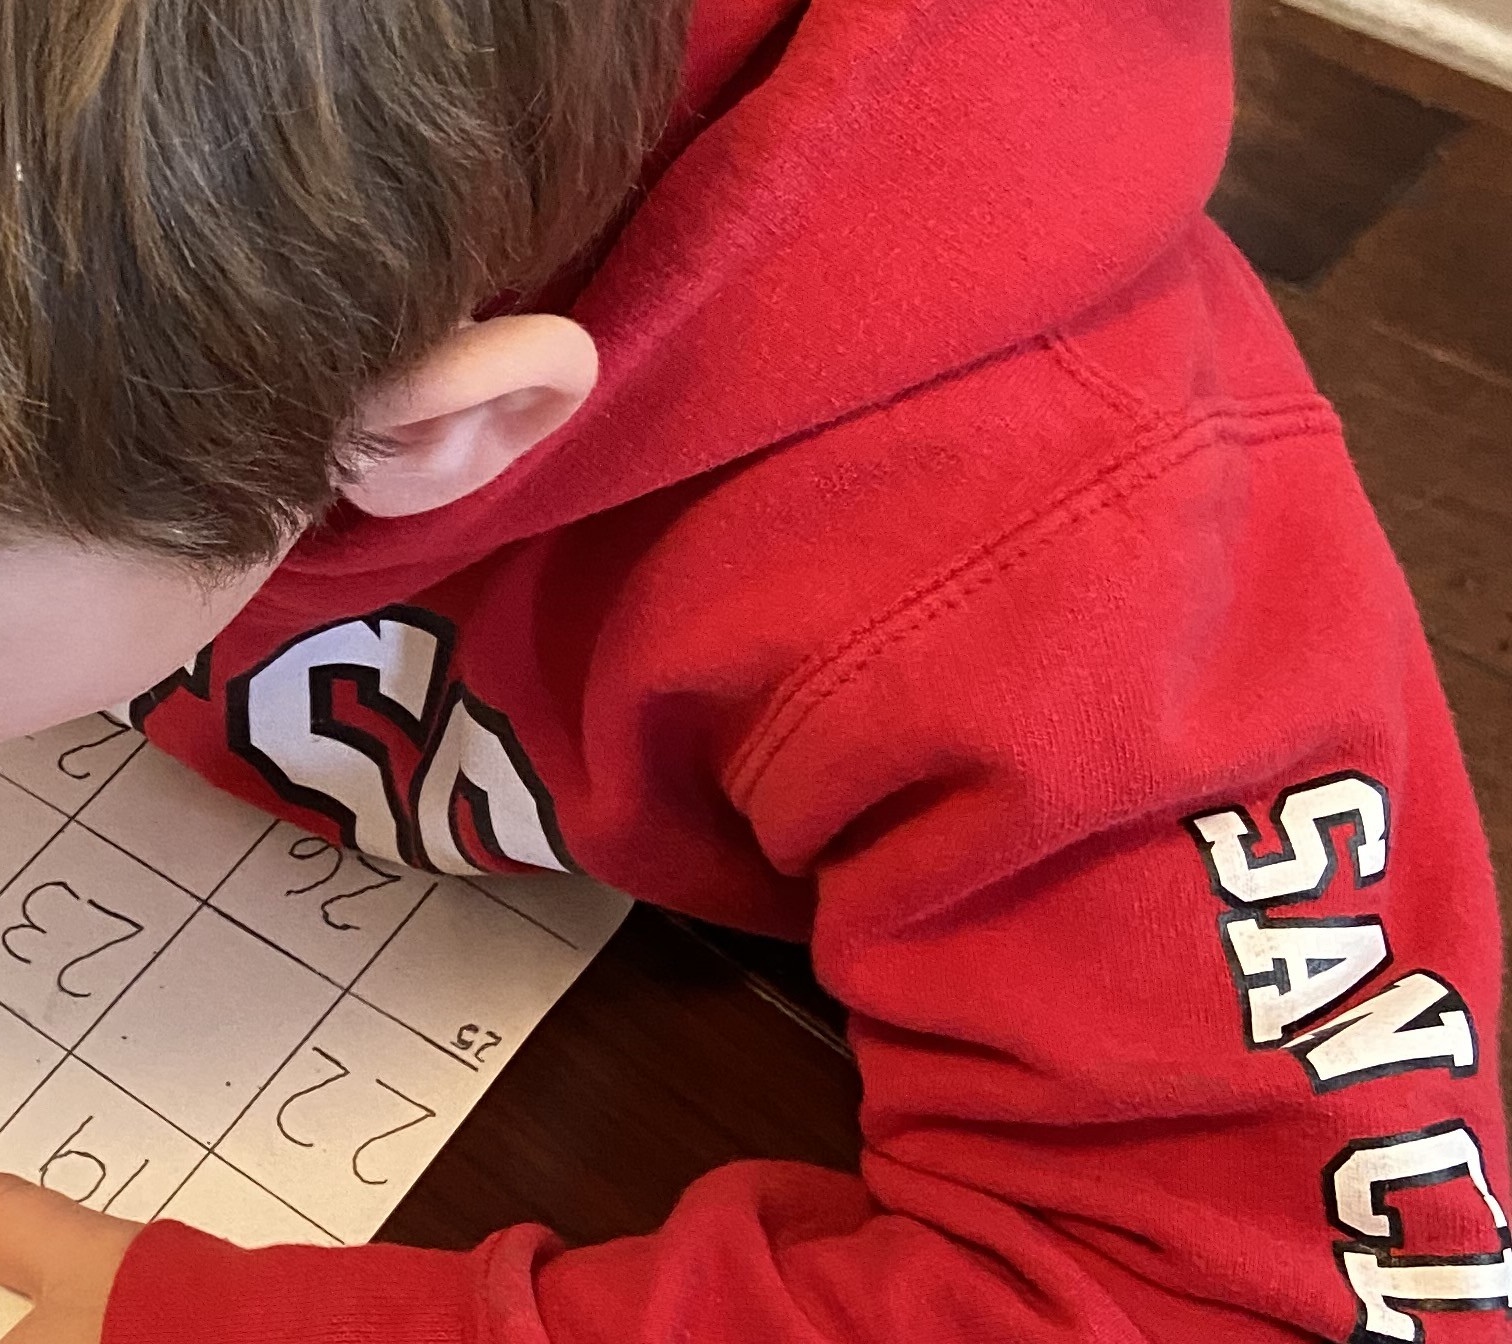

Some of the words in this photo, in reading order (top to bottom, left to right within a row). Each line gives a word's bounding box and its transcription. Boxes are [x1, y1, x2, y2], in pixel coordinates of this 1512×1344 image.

[56, 709, 134, 779] 2
[284, 836, 403, 932] 26
[1179, 770, 1478, 1094] SAN
[0, 880, 145, 999] 23
[449, 1022, 503, 1064] 25
[276, 1045, 438, 1186] 22
